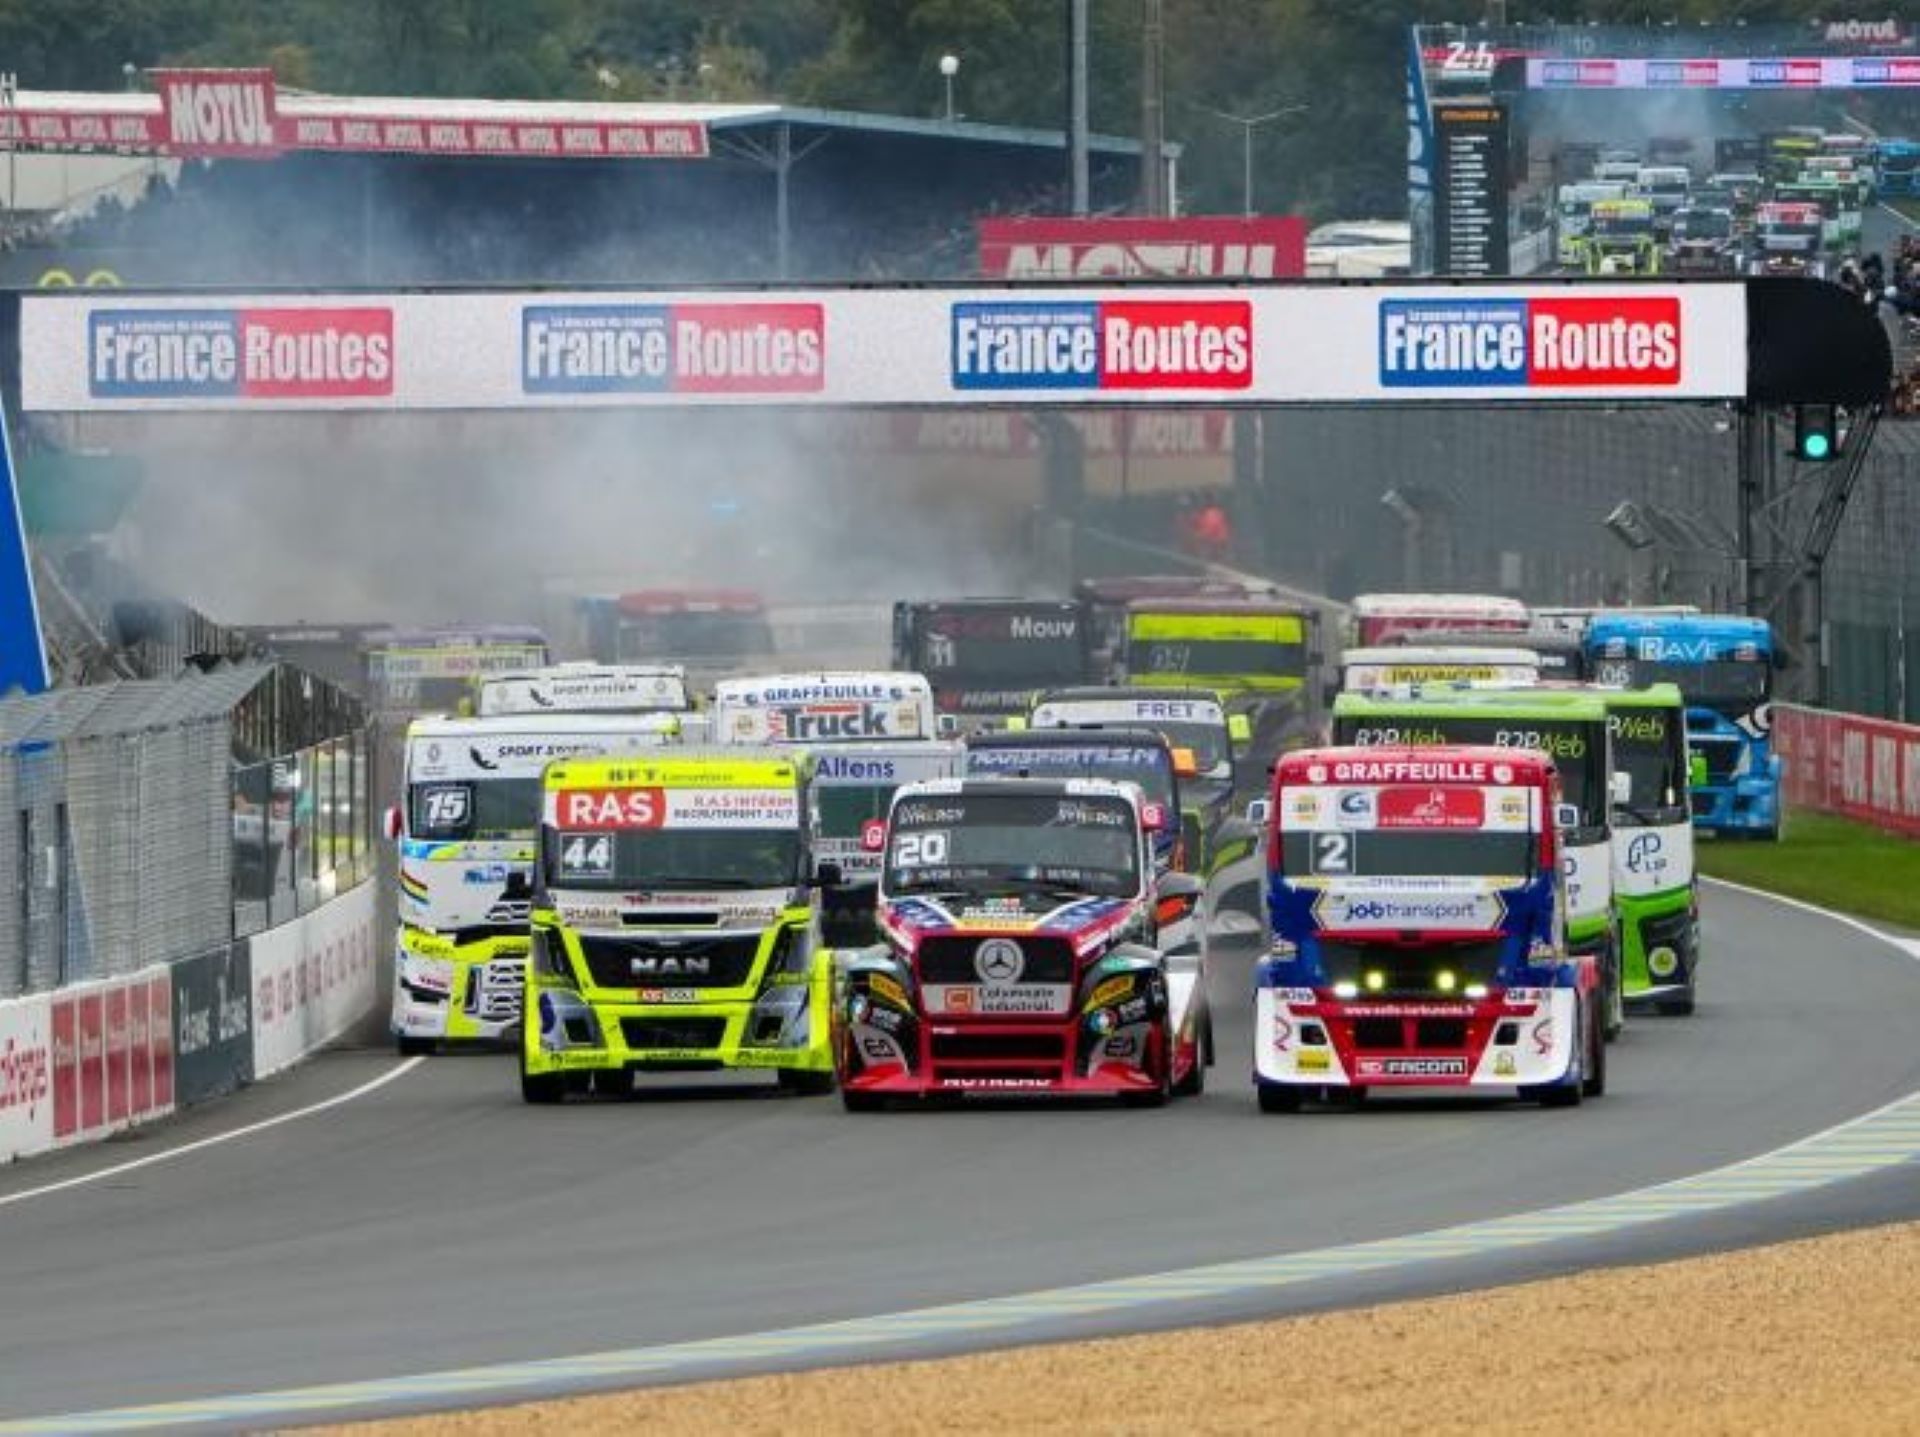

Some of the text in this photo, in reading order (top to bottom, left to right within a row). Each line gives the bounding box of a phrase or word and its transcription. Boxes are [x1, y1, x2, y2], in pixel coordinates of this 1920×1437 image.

[168, 83, 272, 144] MOTUL
[95, 325, 389, 382] France Routes
[527, 320, 820, 378] France Routes
[957, 317, 1248, 374] France Routes
[1386, 314, 1677, 371] France Routes
[763, 685, 882, 701] GRAFFEUILLE
[1136, 702, 1196, 718] FRET
[781, 703, 887, 738] Truck
[1335, 762, 1486, 781] GRAFFEUILLE
[427, 791, 467, 827] 15
[564, 837, 611, 868] 44
[899, 833, 946, 864] 20
[1319, 834, 1348, 870] 2
[630, 957, 710, 974] MAN
